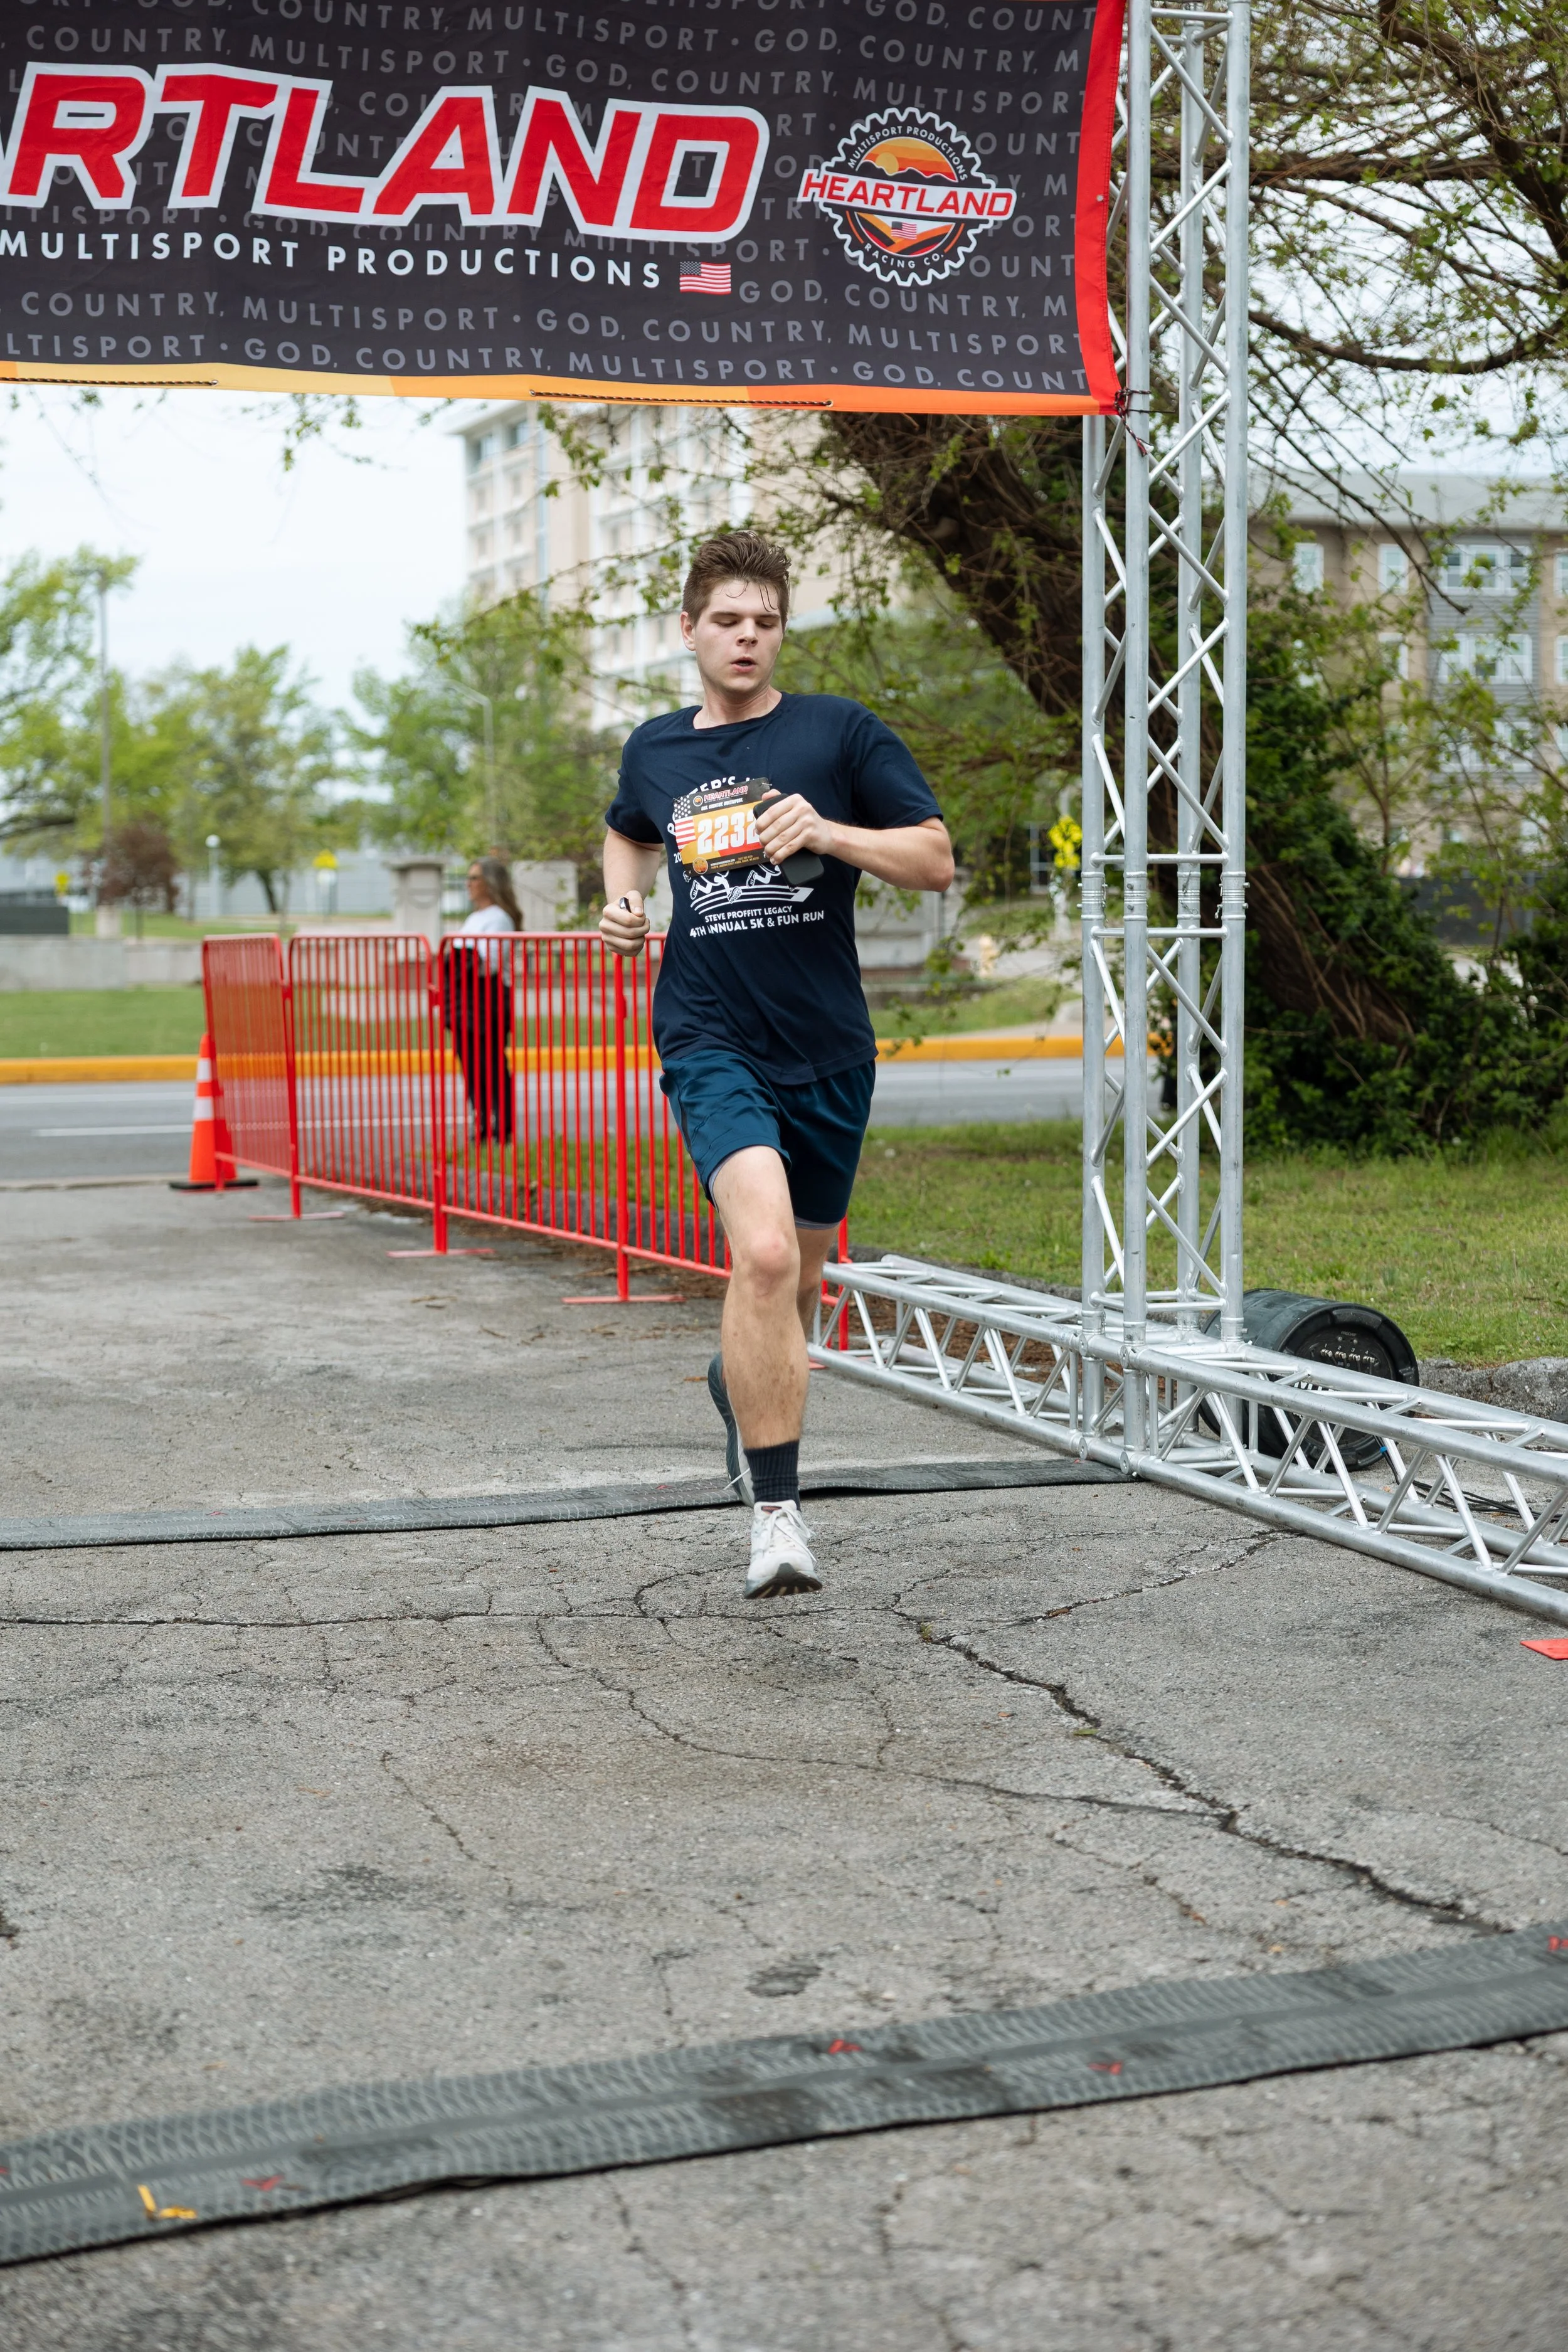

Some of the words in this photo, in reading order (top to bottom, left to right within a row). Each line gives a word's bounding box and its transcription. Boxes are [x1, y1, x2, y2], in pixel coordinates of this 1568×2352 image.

[26, 25, 231, 55] COUNTRY,
[250, 34, 509, 74] MULTISPORT
[546, 54, 632, 90] GOD,
[651, 68, 837, 97] COUNTRY,
[467, 8, 719, 51] MULTISPORT
[755, 28, 840, 55] GOD,
[859, 36, 1038, 74] COUNTRY,
[0, 61, 770, 243] RTLAND
[847, 125, 903, 169] MULTISPORT
[906, 125, 968, 182] PRODUCTIONS
[956, 130, 1080, 156] OUNT
[797, 169, 1017, 221] HEARTLAND
[0, 229, 299, 268] MULTISPORT
[327, 245, 660, 289] PRODUCTIONS
[864, 243, 916, 269] RACING
[923, 253, 944, 266] CO.
[949, 254, 1074, 278] OUNT
[21, 290, 225, 317] COUNTRY,
[243, 296, 498, 331] MULTISPORT
[536, 308, 625, 341] GOD,
[643, 319, 831, 343] COUNTRY,
[739, 280, 828, 304] GOD,
[844, 284, 1026, 319] COUNTRY,
[245, 337, 337, 368] GOD,
[356, 347, 551, 371] COUNTRY,
[569, 351, 815, 379] MULTISPORT
[853, 361, 941, 386] GOD,
[704, 785, 748, 802] HEARTLAND
[689, 925, 707, 938] 4TH
[708, 919, 748, 935] ANNUAL
[750, 918, 765, 930] 5K
[767, 917, 775, 927] &
[777, 913, 800, 926] FUN
[803, 910, 825, 923] RUN
[704, 913, 726, 923] STEVE
[727, 909, 762, 919] PROFFITT
[764, 905, 792, 916] LEGACY
